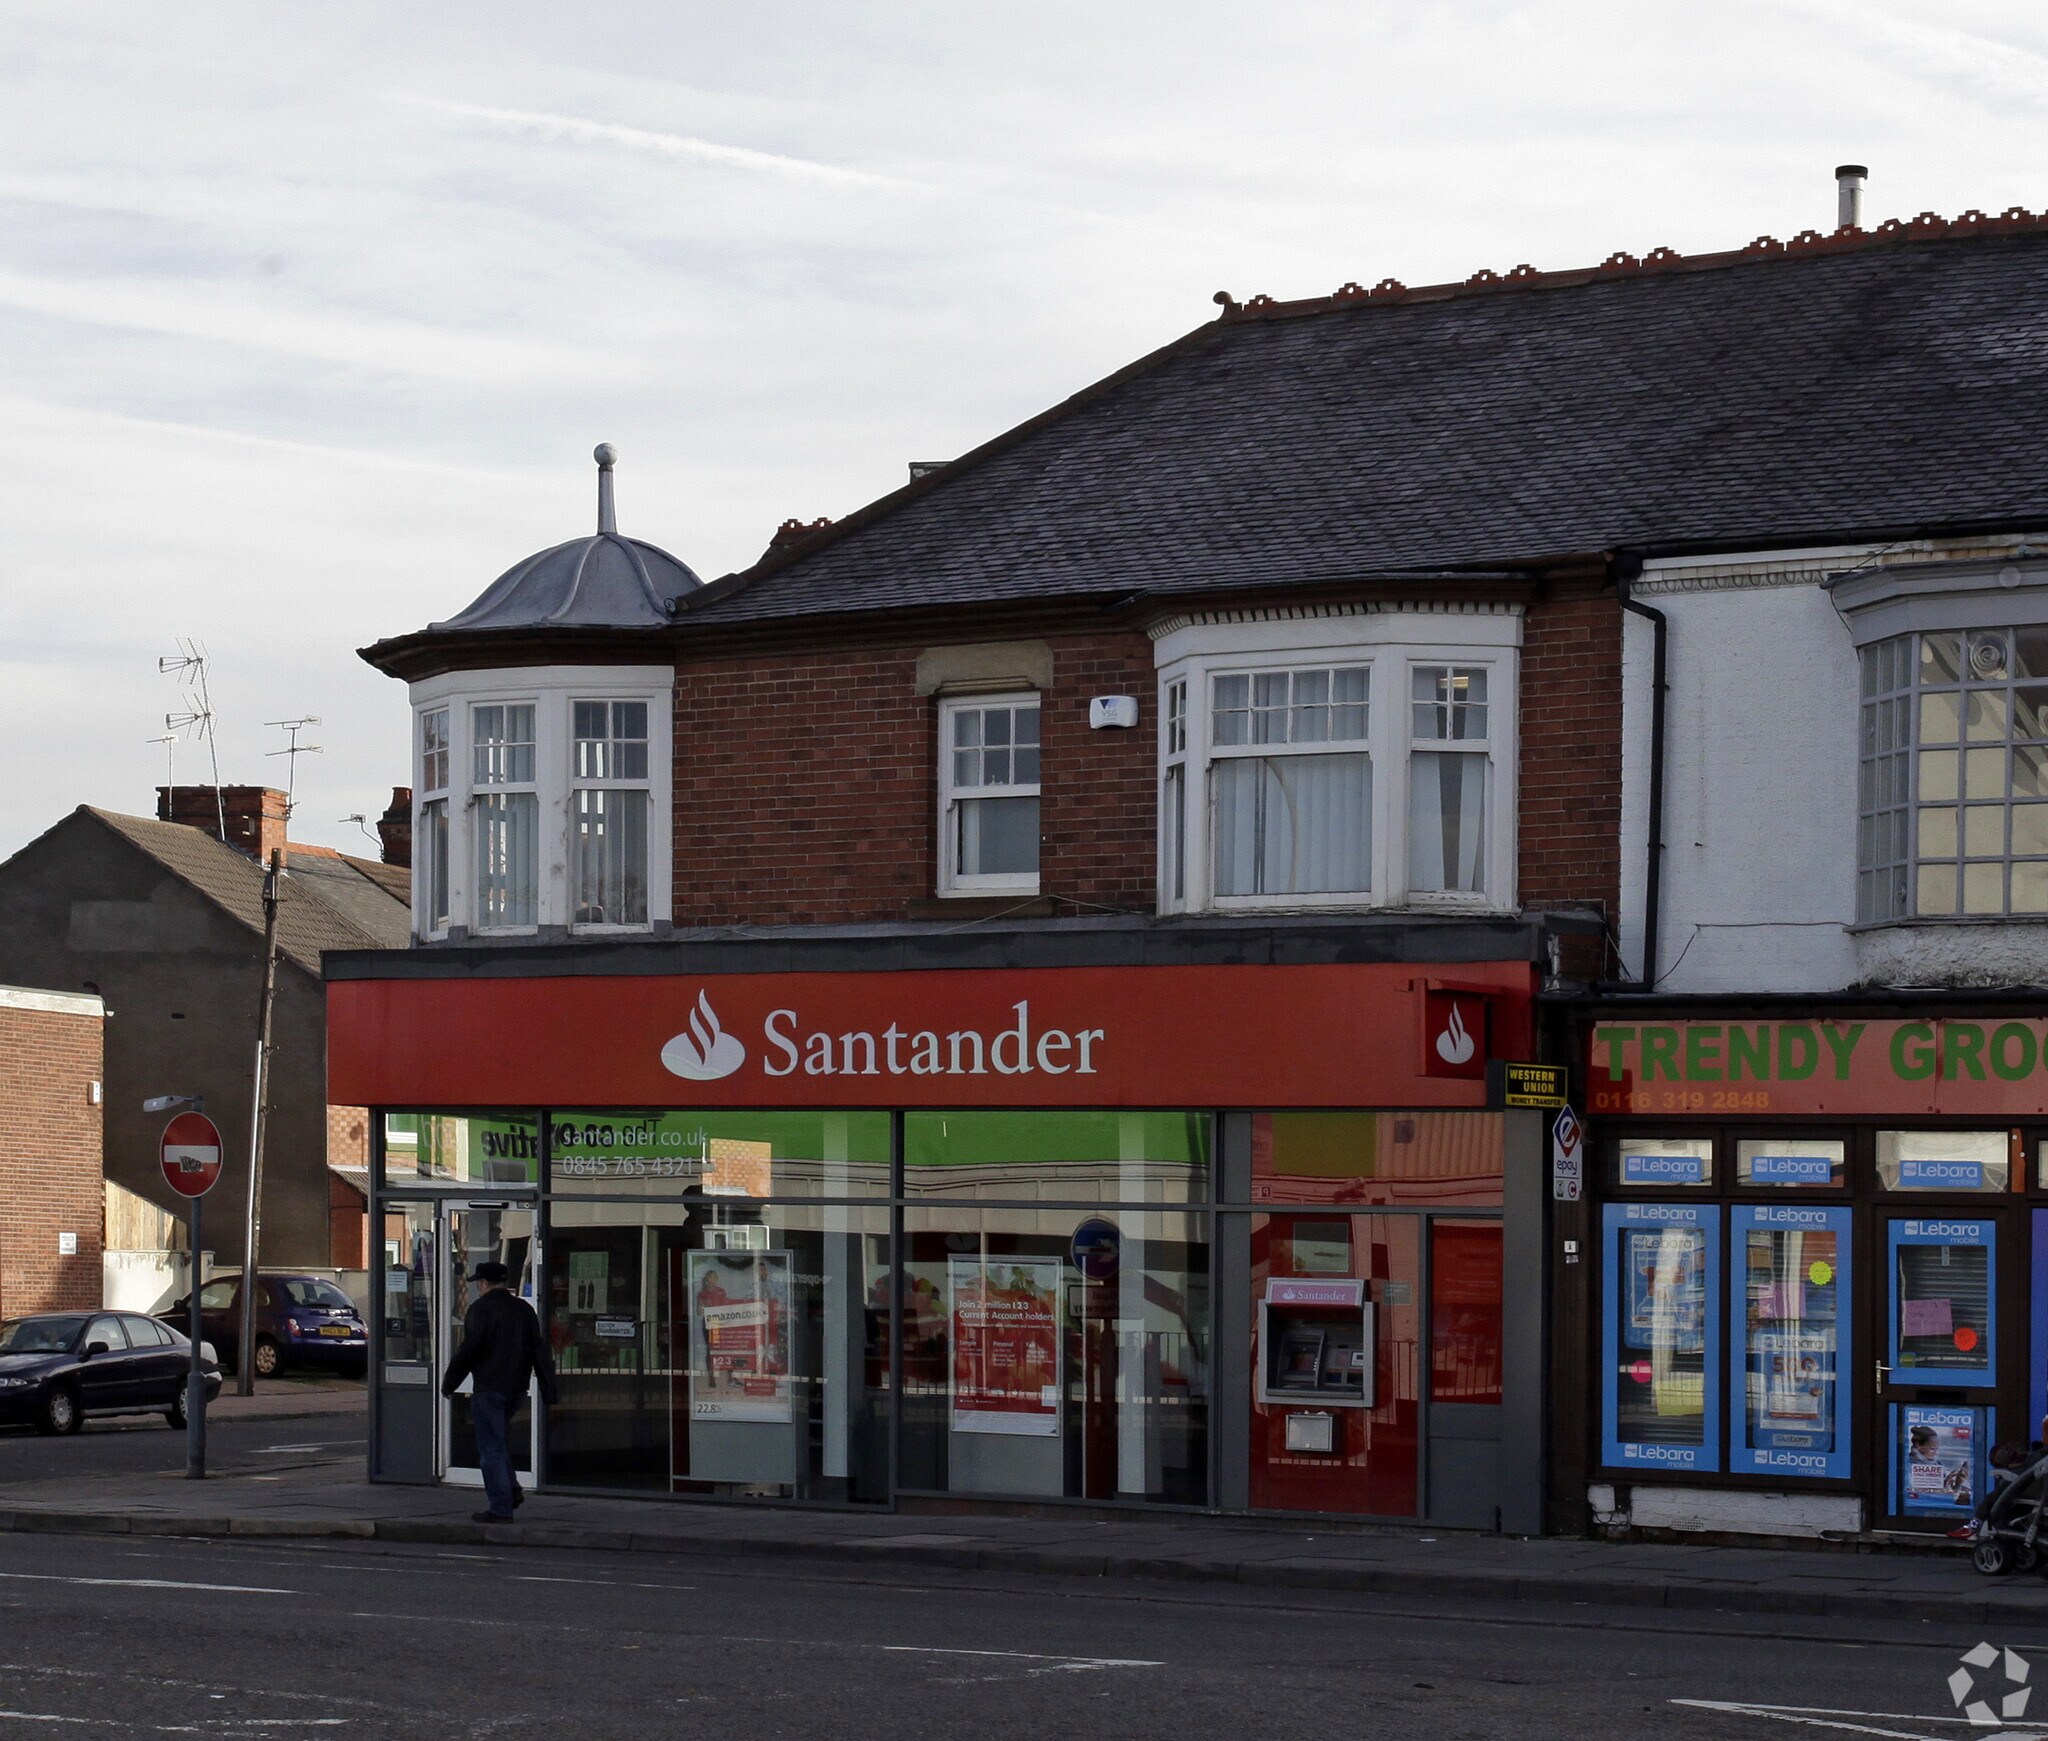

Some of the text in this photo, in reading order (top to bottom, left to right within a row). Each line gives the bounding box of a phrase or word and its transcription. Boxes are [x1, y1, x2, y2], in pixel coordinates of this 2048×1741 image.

[763, 999, 1105, 1077] Santander
[1596, 1022, 2048, 1082] TRENDY GRO
[1509, 1069, 1555, 1081] WESTERN
[1523, 1082, 1555, 1094] UNION
[1511, 1096, 1562, 1106] MONEY TRANSFER
[1595, 1091, 1770, 1109] 0116 319 2848
[562, 1126, 708, 1146] santander.co.uk
[562, 1156, 693, 1175] 0845 765 4321
[1556, 1160, 1578, 1175] epay
[1642, 1158, 1698, 1172] Lebara
[1768, 1158, 1829, 1174] Lebara
[1917, 1163, 1978, 1178] Lebara
[1640, 1206, 1696, 1220] Lebara
[1768, 1206, 1827, 1222] Lebara
[1798, 1222, 1826, 1230] mobile
[1919, 1222, 1980, 1236] Lebara
[1297, 1288, 1346, 1300] Santander
[958, 1300, 975, 1309] Join
[984, 1300, 1011, 1309] million
[959, 1310, 989, 1319] Current
[991, 1311, 1023, 1320] Account
[1920, 1411, 1971, 1425] Lebara
[1638, 1445, 1694, 1462] Lebara
[1768, 1451, 1826, 1468] Lebara
[1666, 1461, 1694, 1469] mobile
[1798, 1467, 1826, 1476] mobile
